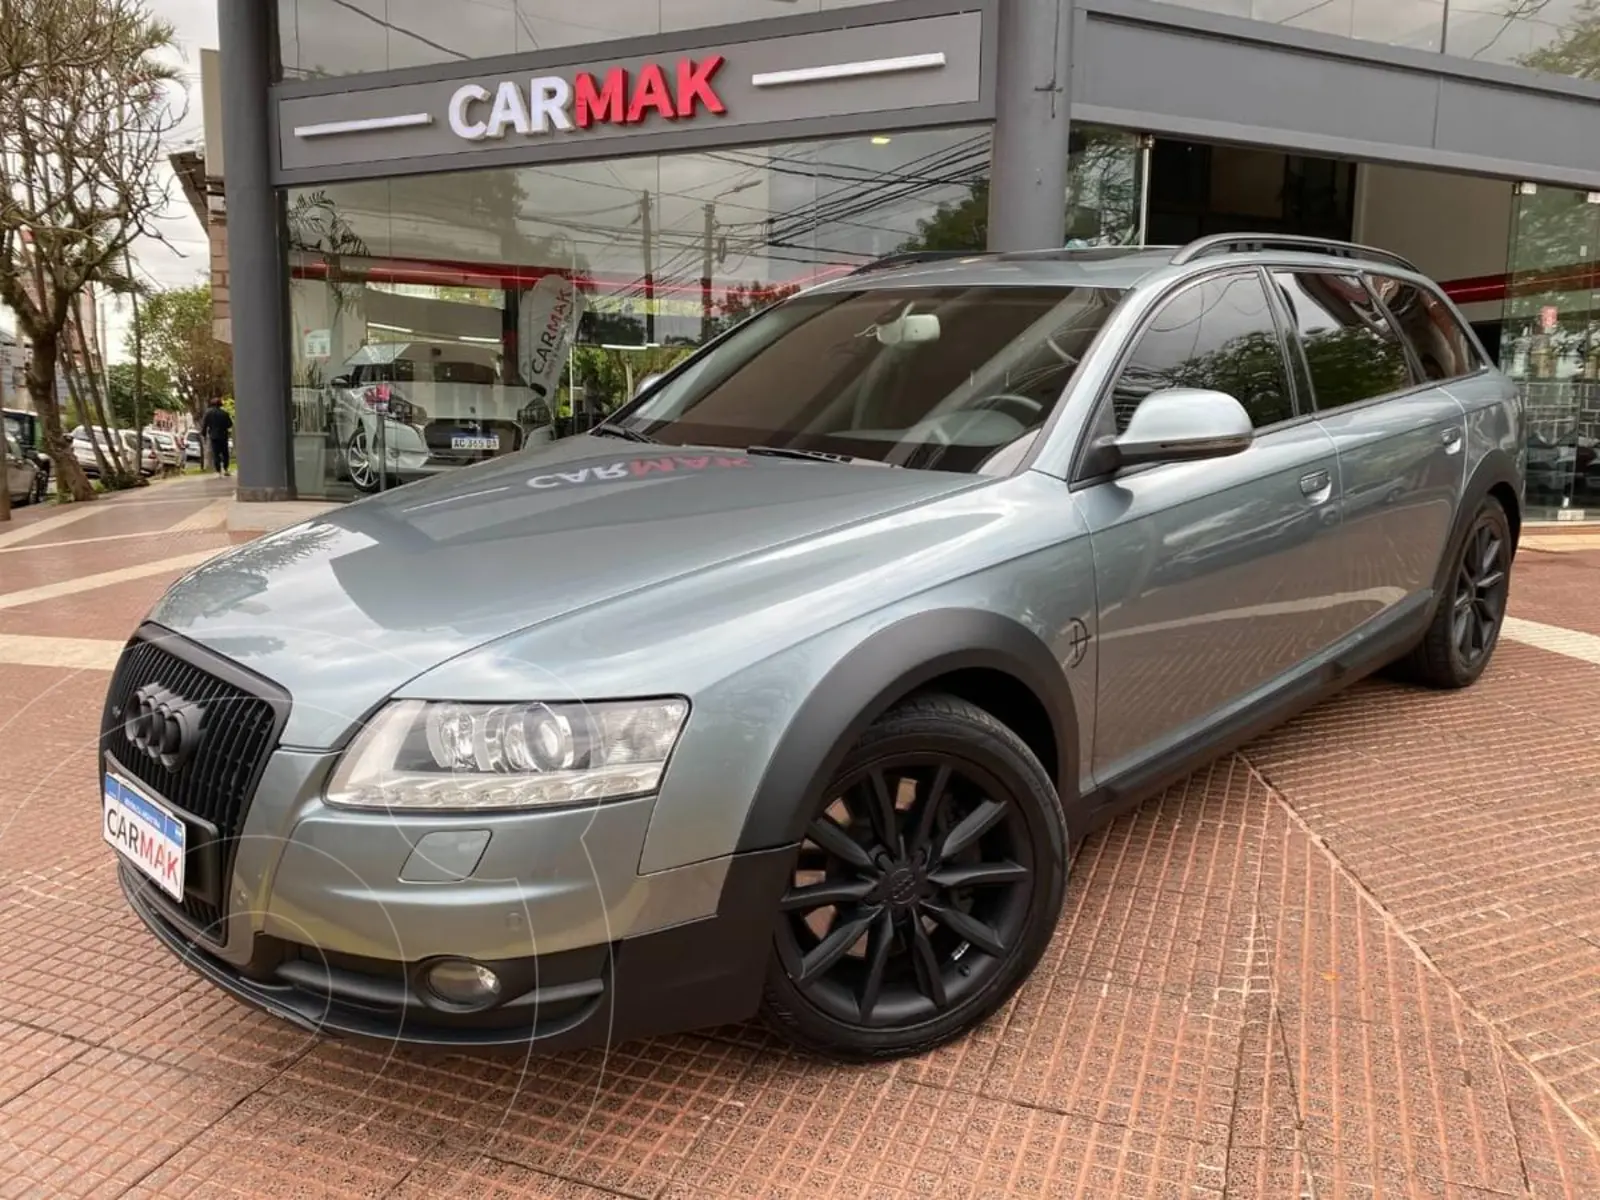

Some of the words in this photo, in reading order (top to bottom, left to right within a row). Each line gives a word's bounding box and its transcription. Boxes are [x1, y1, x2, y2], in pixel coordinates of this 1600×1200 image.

[448, 54, 727, 141] CARMAK
[531, 288, 573, 375] CARMAK
[106, 808, 179, 888] CARMAK
